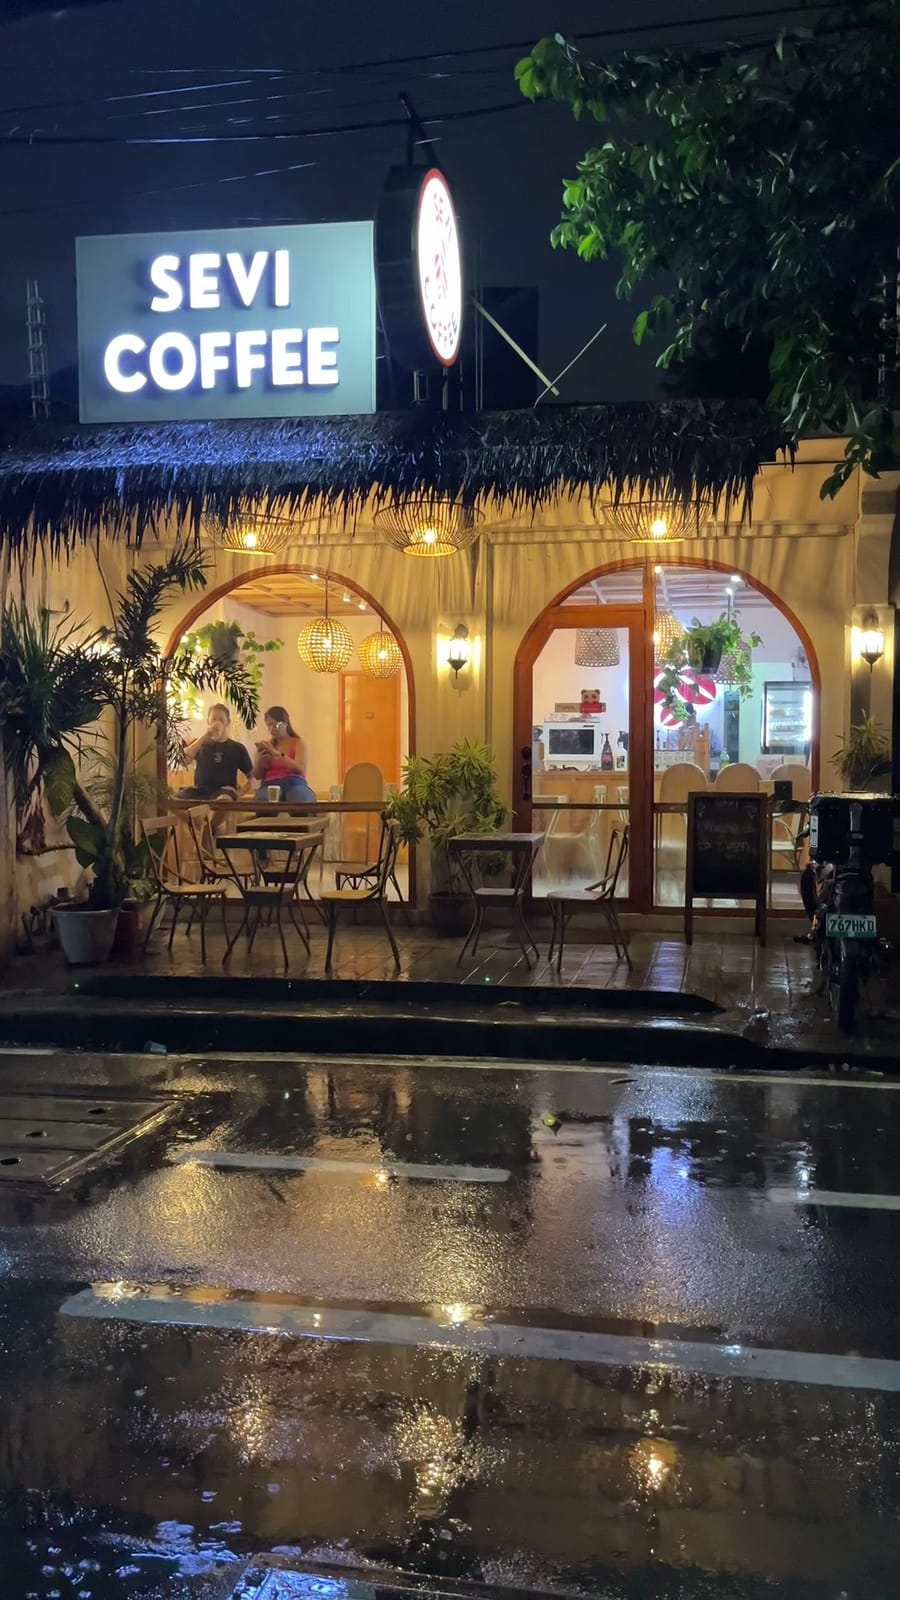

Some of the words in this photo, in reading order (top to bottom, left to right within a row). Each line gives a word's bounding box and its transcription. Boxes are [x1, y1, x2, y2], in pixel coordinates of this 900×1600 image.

[150, 249, 290, 312] SEVI
[103, 327, 339, 393] COFFEE
[829, 919, 875, 932] 767HKD
